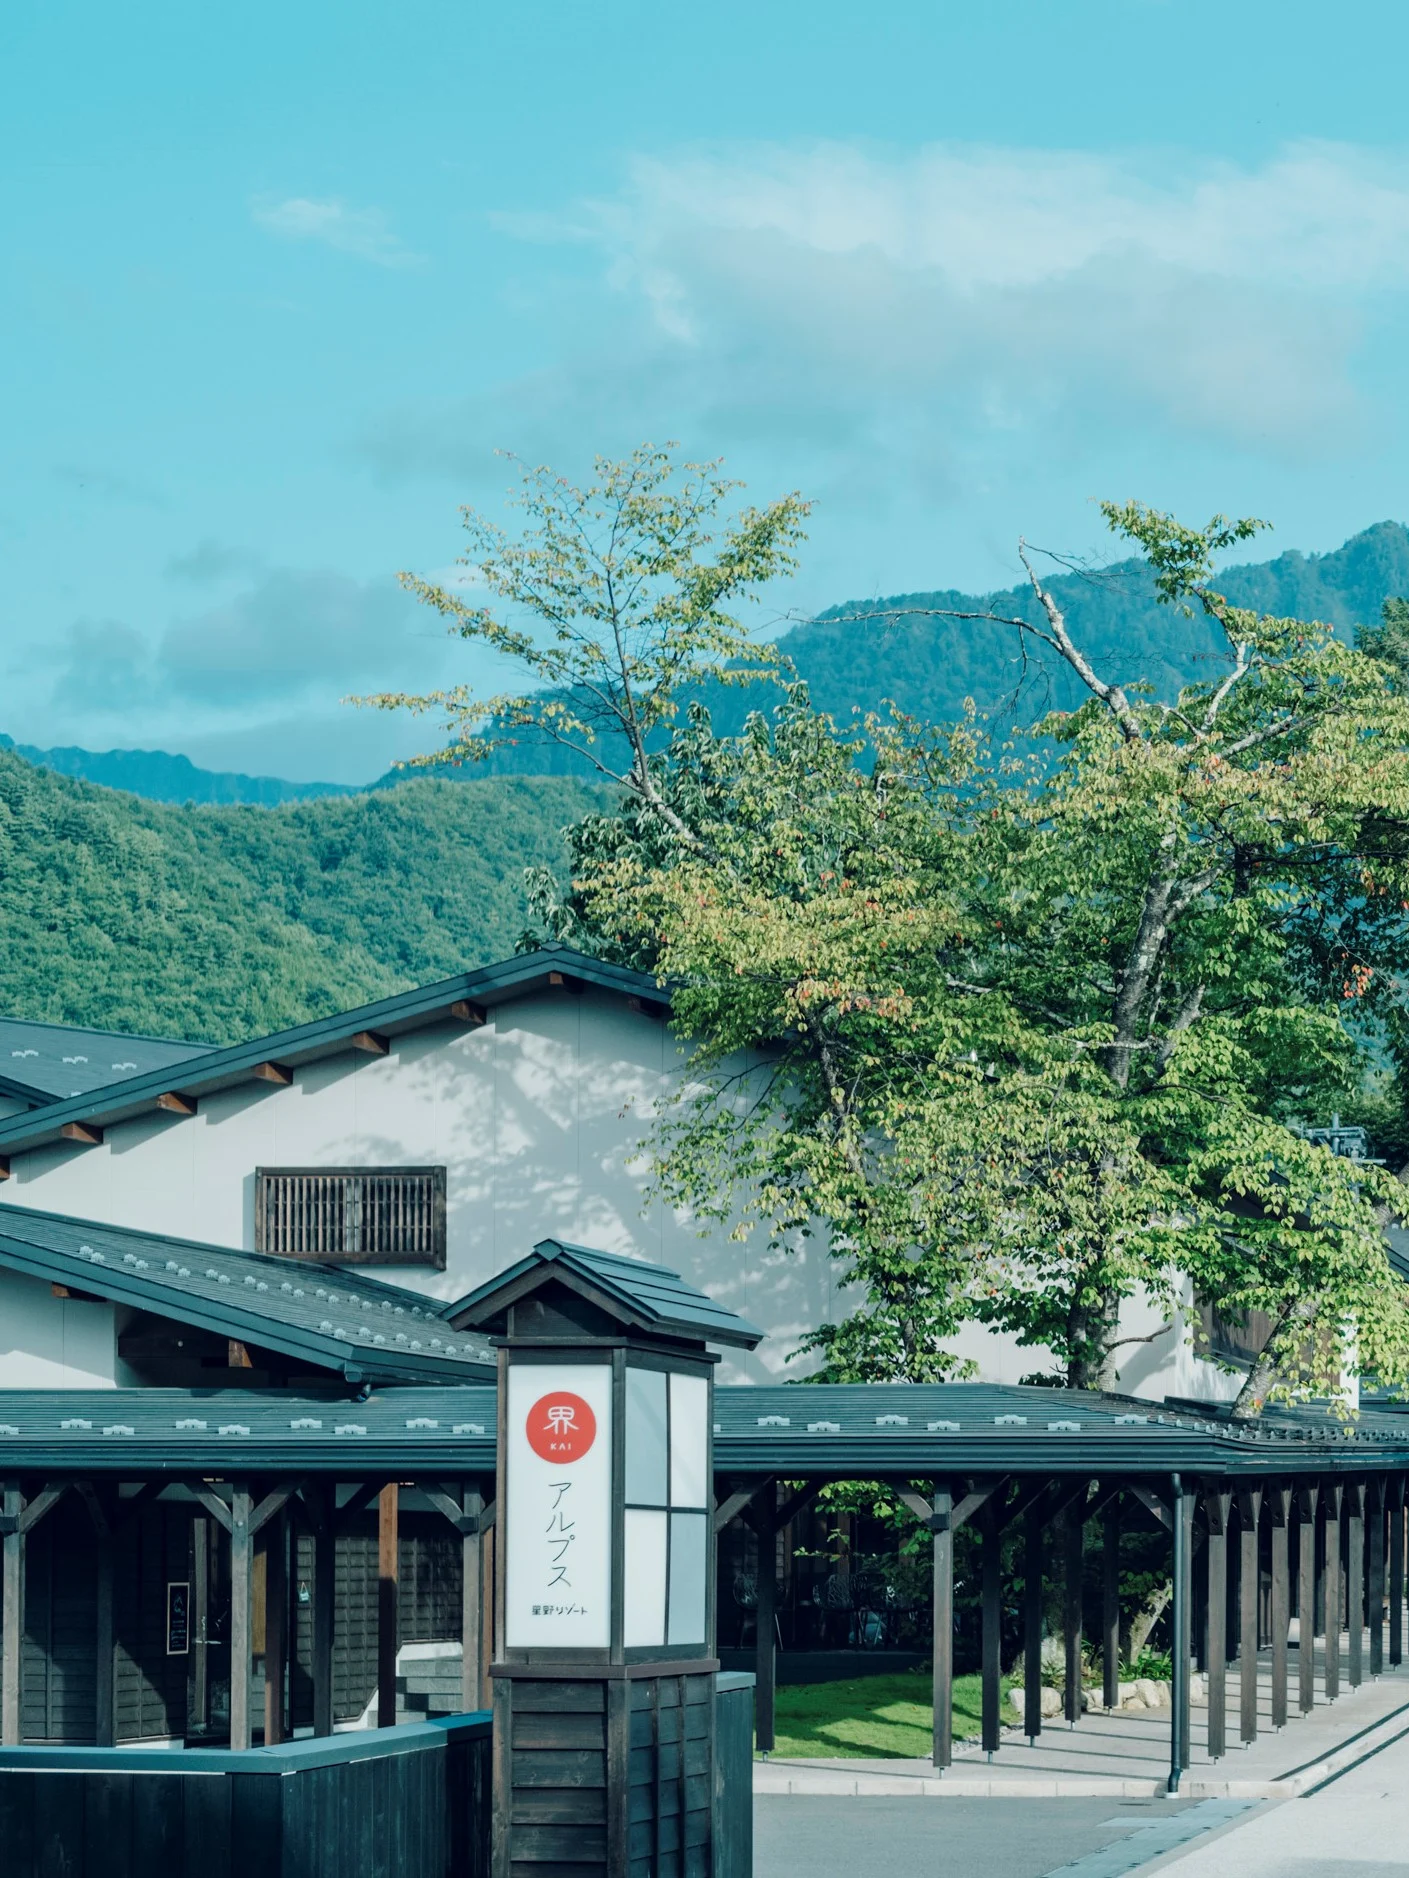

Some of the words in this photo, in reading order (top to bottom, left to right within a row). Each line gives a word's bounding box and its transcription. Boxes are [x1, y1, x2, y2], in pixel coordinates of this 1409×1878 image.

[543, 1405, 580, 1435] 界
[550, 1442, 572, 1450] KAI
[545, 1482, 576, 1587] アルプス
[531, 1603, 588, 1616] 星野リゾート
